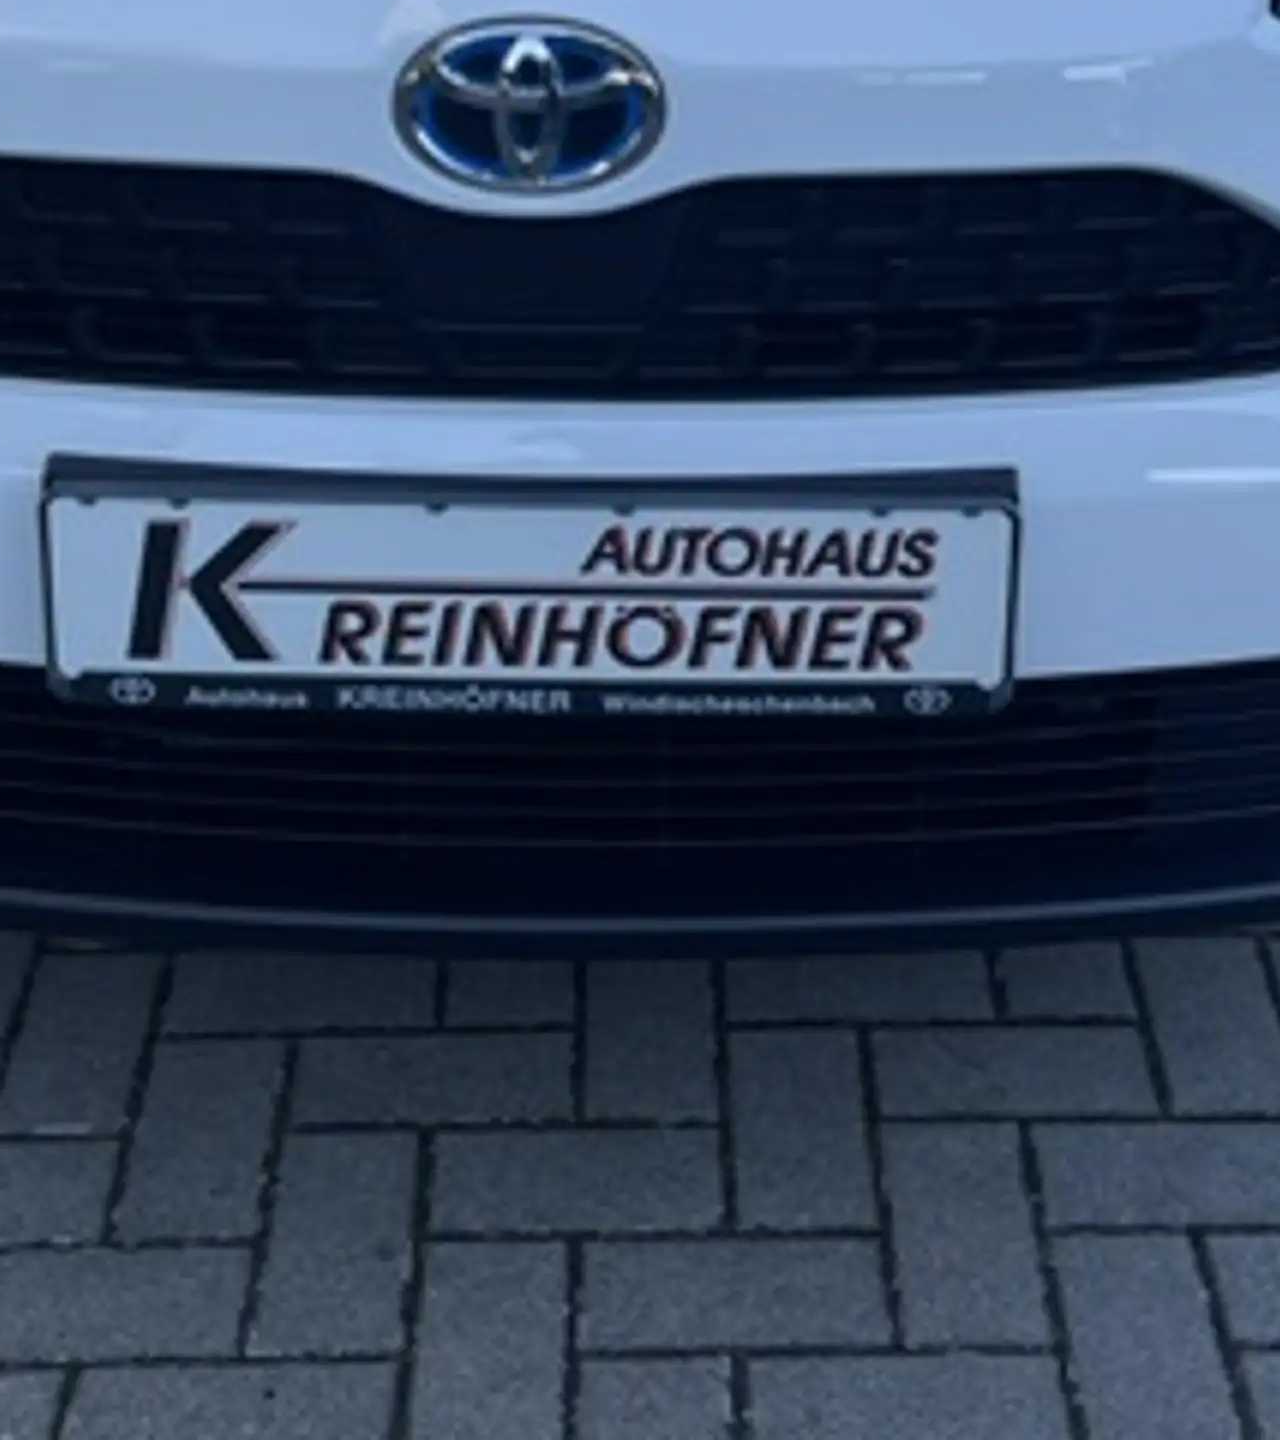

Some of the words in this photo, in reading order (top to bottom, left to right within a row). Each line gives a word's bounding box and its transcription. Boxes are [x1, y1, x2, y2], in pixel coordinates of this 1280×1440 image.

[579, 523, 940, 578] AUTOHAUS
[183, 685, 309, 710] Autohaus
[336, 683, 572, 714] KREINHÖFNER
